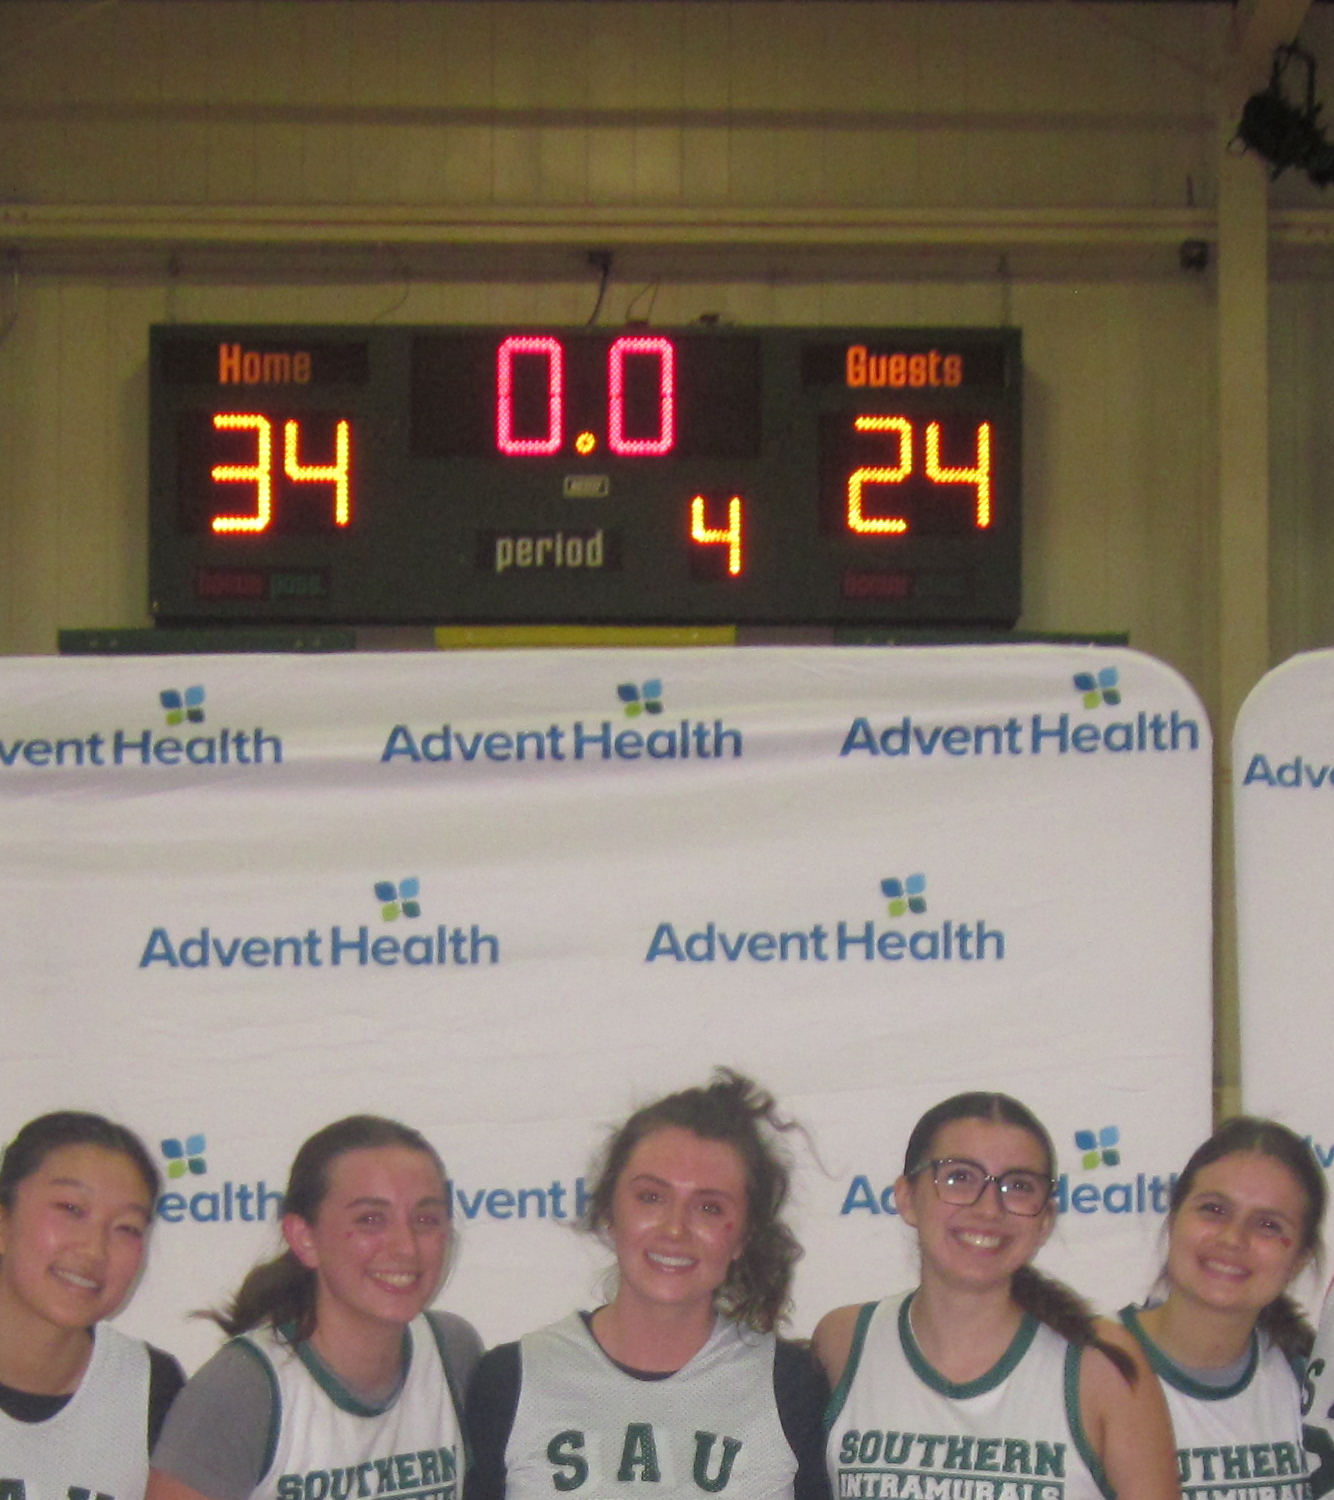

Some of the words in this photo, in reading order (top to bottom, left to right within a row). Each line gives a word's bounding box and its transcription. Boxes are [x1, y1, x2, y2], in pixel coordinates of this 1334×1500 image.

[218, 343, 312, 384] Home
[846, 346, 962, 388] Guests
[211, 413, 351, 534] 34
[847, 415, 992, 534] 24
[495, 532, 605, 572] period
[691, 495, 742, 576] 4
[381, 721, 742, 763] AdventHealth
[840, 710, 1199, 756] AdventHealth
[140, 926, 498, 968] AdventHealth
[646, 922, 1004, 962] AdventHealth
[838, 1429, 1066, 1478] SOUTHERN
